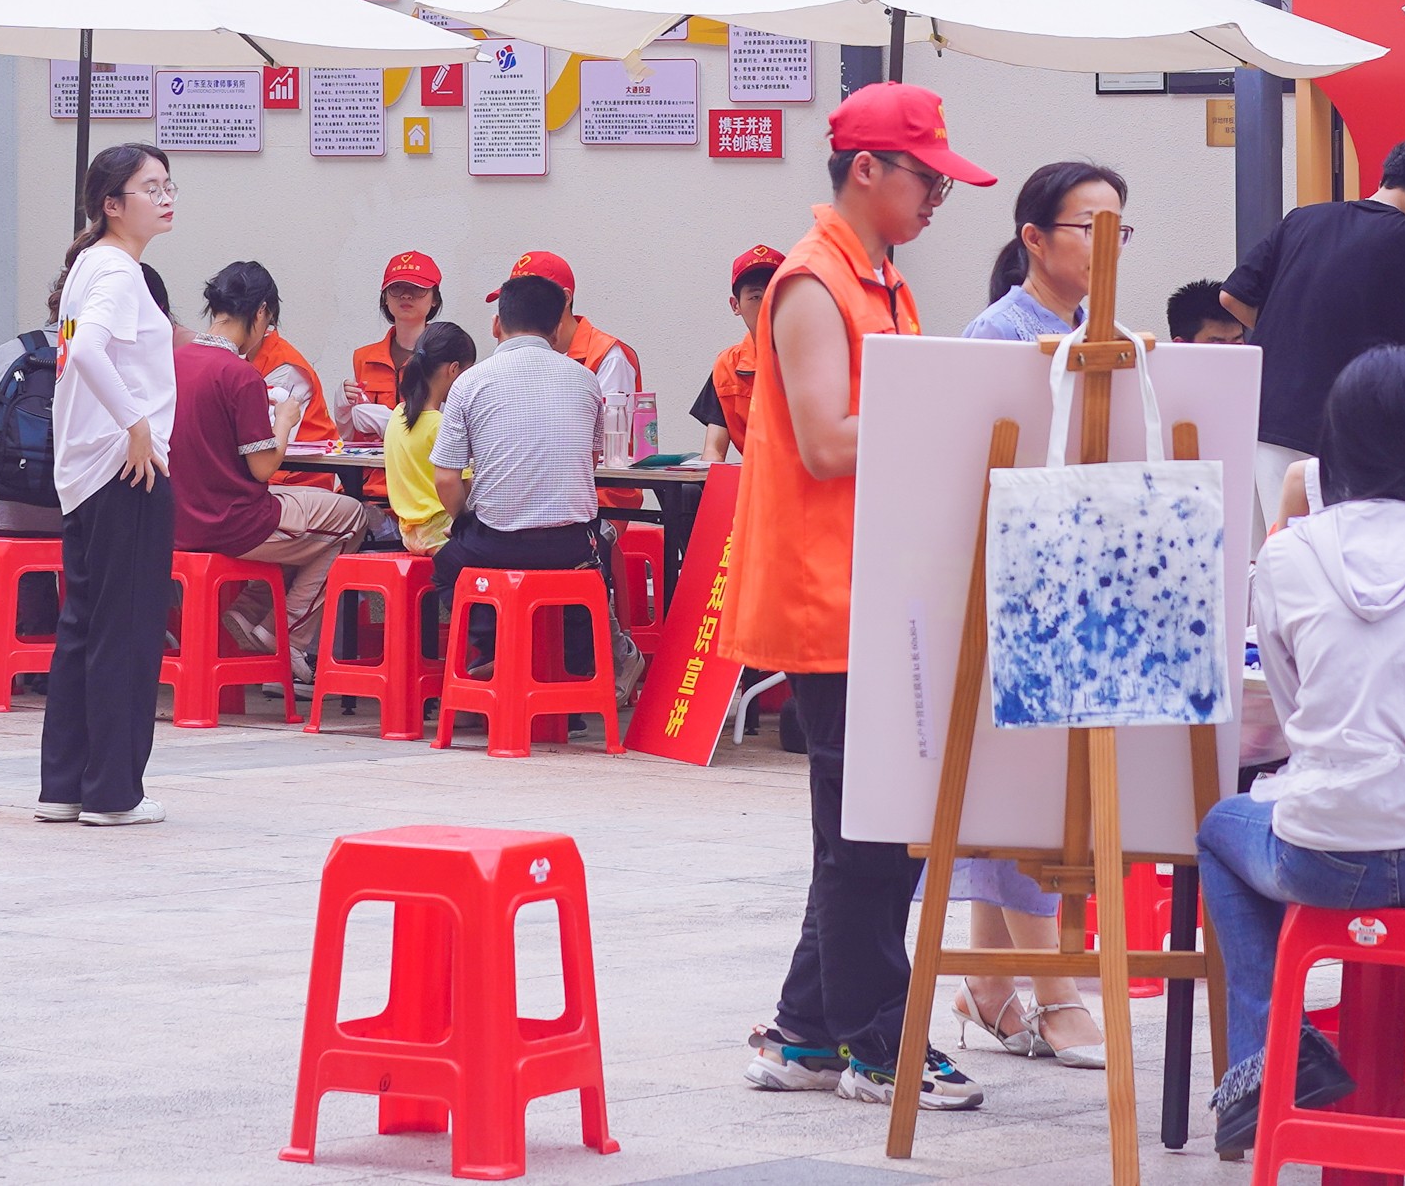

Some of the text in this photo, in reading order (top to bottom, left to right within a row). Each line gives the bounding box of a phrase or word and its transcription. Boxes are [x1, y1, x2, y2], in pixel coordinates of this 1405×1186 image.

[718, 116, 773, 134] 携手并进
[718, 134, 773, 153] 共创辉煌
